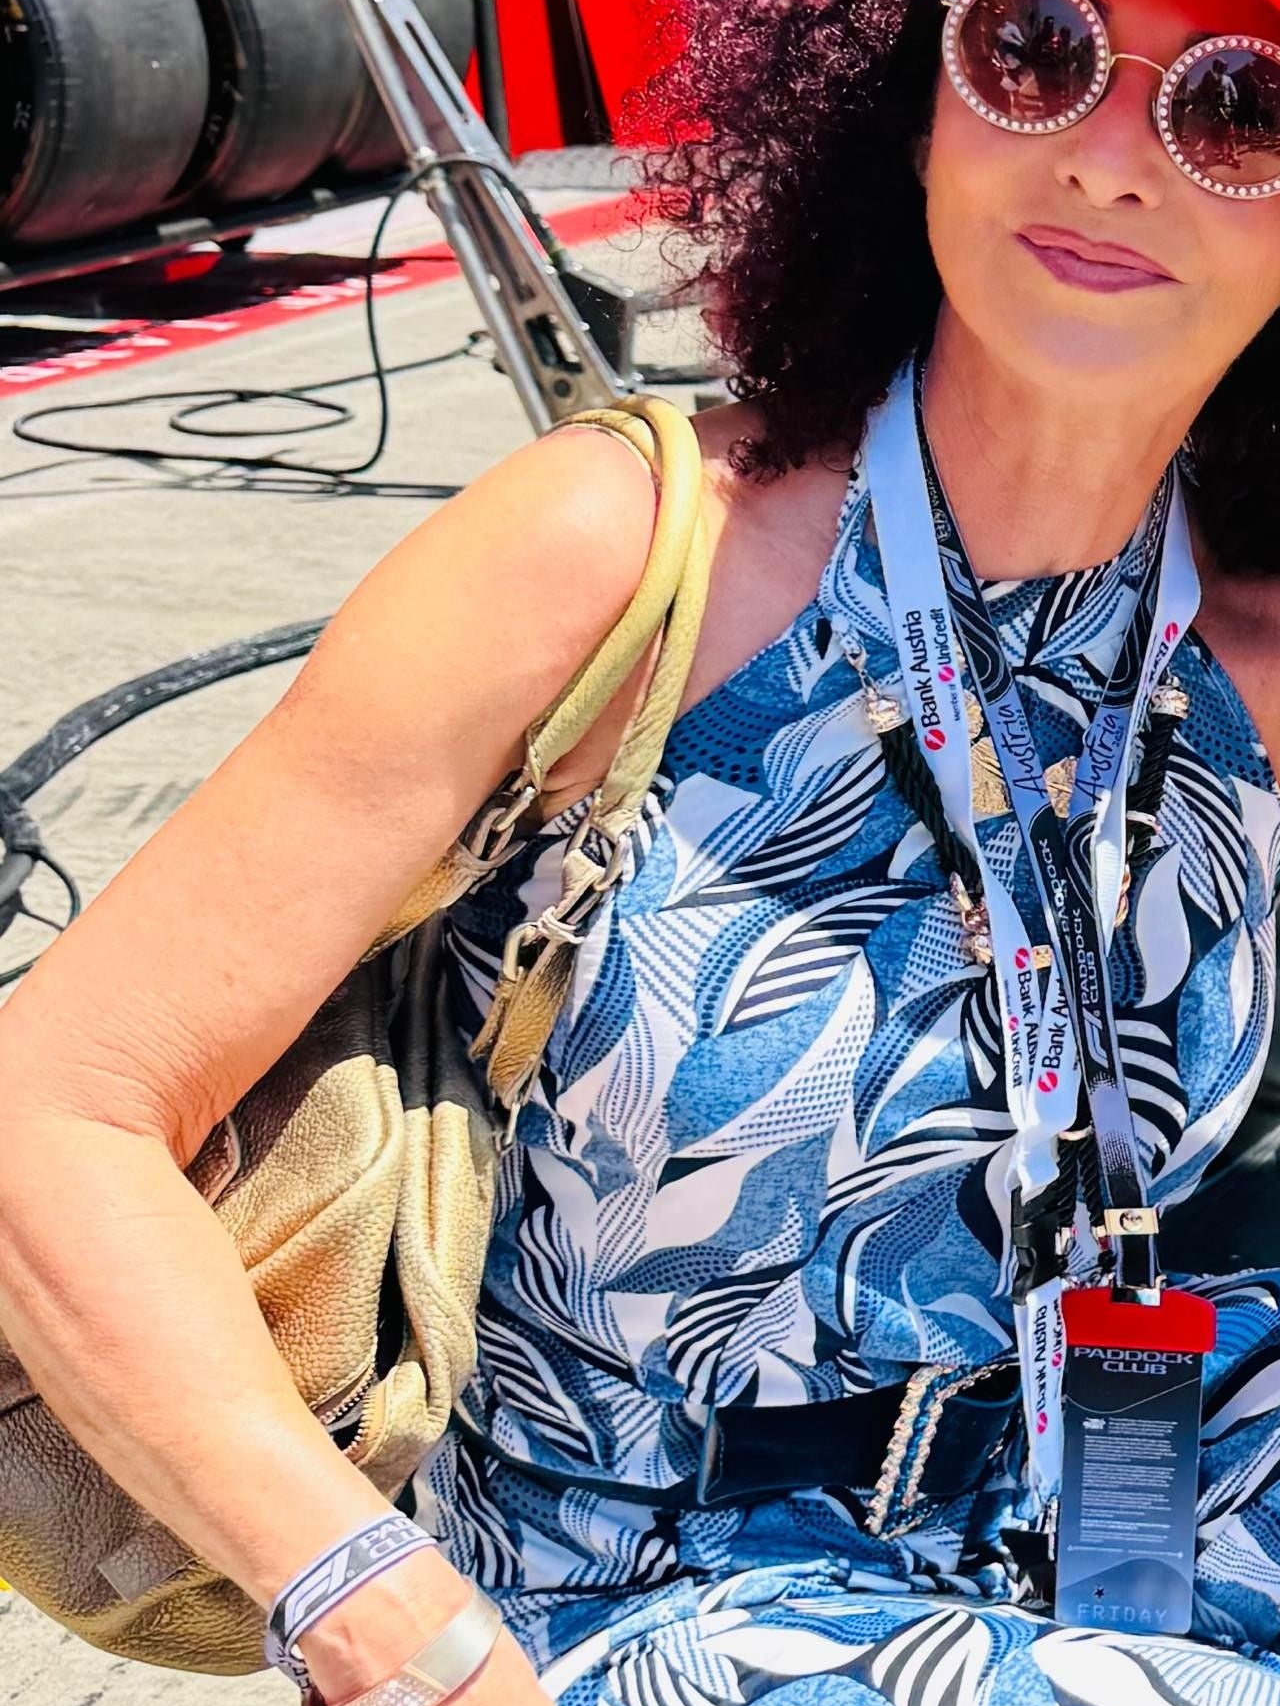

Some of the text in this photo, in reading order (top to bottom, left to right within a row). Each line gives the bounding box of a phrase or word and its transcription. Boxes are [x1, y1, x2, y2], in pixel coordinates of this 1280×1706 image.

[930, 607, 953, 667] UniCredit
[902, 609, 942, 729] Bank Austria
[996, 702, 1049, 799] Austria
[1073, 712, 1121, 808] Austria
[1072, 907, 1092, 1006] PADDOCK
[1086, 950, 1100, 1004] CLUB
[1017, 969, 1035, 1020] Bank
[1041, 1021, 1069, 1070] Bank
[1073, 1347, 1194, 1365] PADDOCK
[1102, 1360, 1168, 1376] CLUB
[1076, 1603, 1169, 1625] FRIDAY
